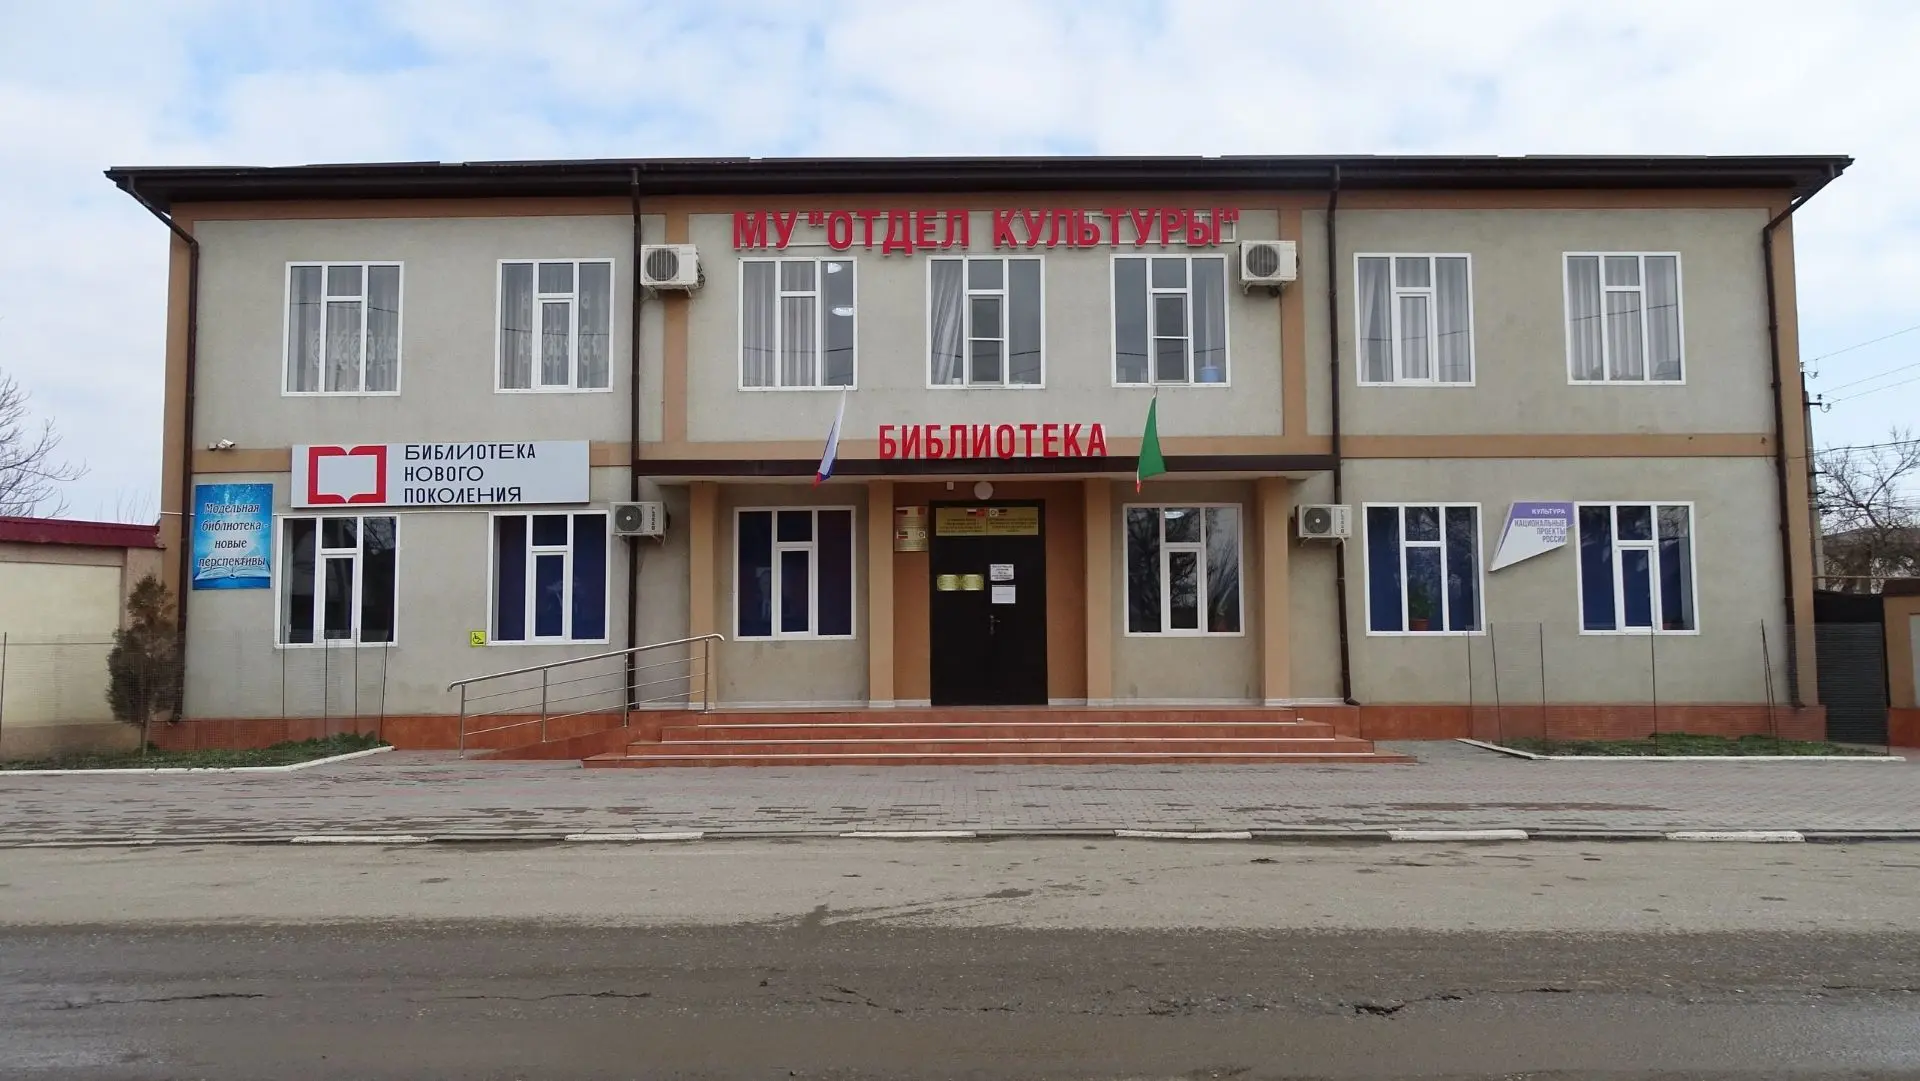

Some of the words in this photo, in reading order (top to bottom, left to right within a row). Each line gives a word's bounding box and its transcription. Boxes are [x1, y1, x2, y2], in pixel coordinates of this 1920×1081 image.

[733, 208, 799, 250] МУ
[808, 208, 970, 257] "ОТДЕЛ
[992, 207, 1240, 249] КУЛЬТУРЫ"
[879, 423, 1108, 460] БИБЛИОТЕКА
[405, 443, 536, 460] БИБЛИОТЕКА
[404, 466, 484, 482] НОВОГО
[404, 486, 521, 503] ПОКОЛЕНИЯ
[205, 502, 260, 514] Модельная
[202, 519, 262, 532] библиотека
[1514, 519, 1566, 528] НАЦИОНАЛЬНЫЕ
[1536, 527, 1566, 535] ПРОЕКТЫ
[214, 539, 248, 549] новые
[1542, 535, 1566, 543] РОССИИ
[199, 557, 266, 569] перспективы
